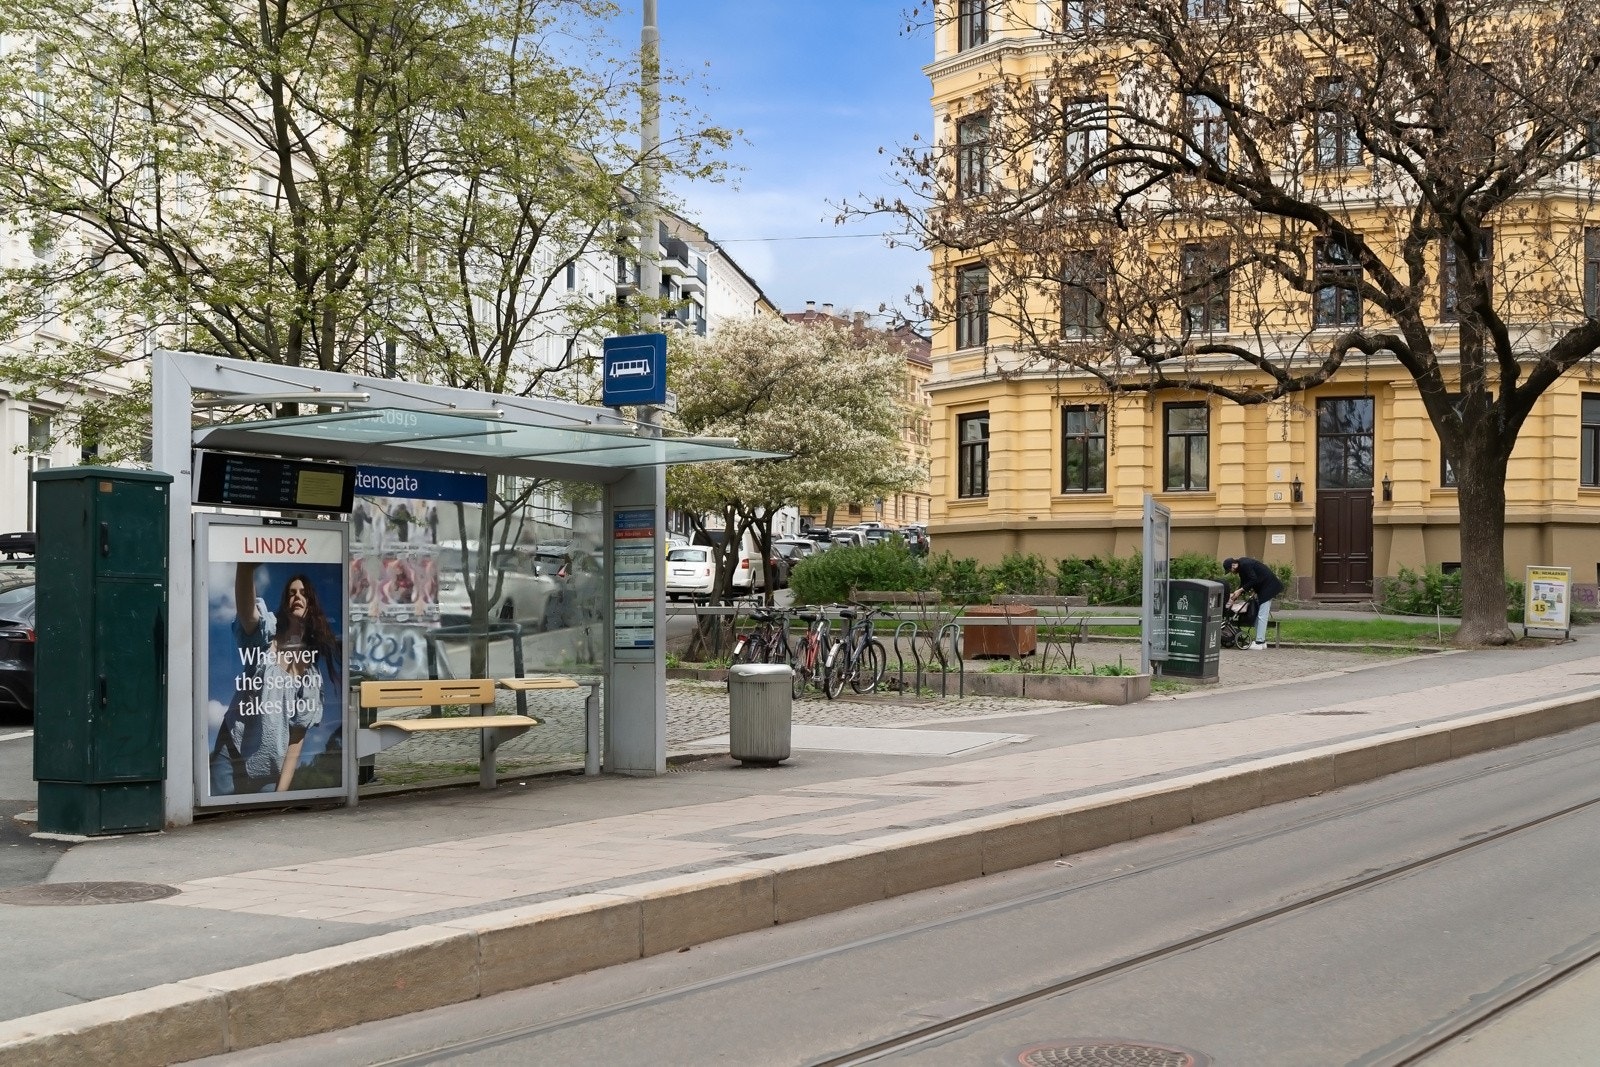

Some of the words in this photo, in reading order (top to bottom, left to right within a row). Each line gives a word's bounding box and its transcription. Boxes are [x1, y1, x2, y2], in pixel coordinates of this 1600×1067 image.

[244, 537, 308, 555] LINDEX
[1534, 604, 1546, 612] 15
[238, 647, 319, 666] Wherever
[235, 672, 263, 691] the
[266, 673, 323, 690] season
[239, 696, 282, 716] takes
[286, 697, 320, 718] you.
